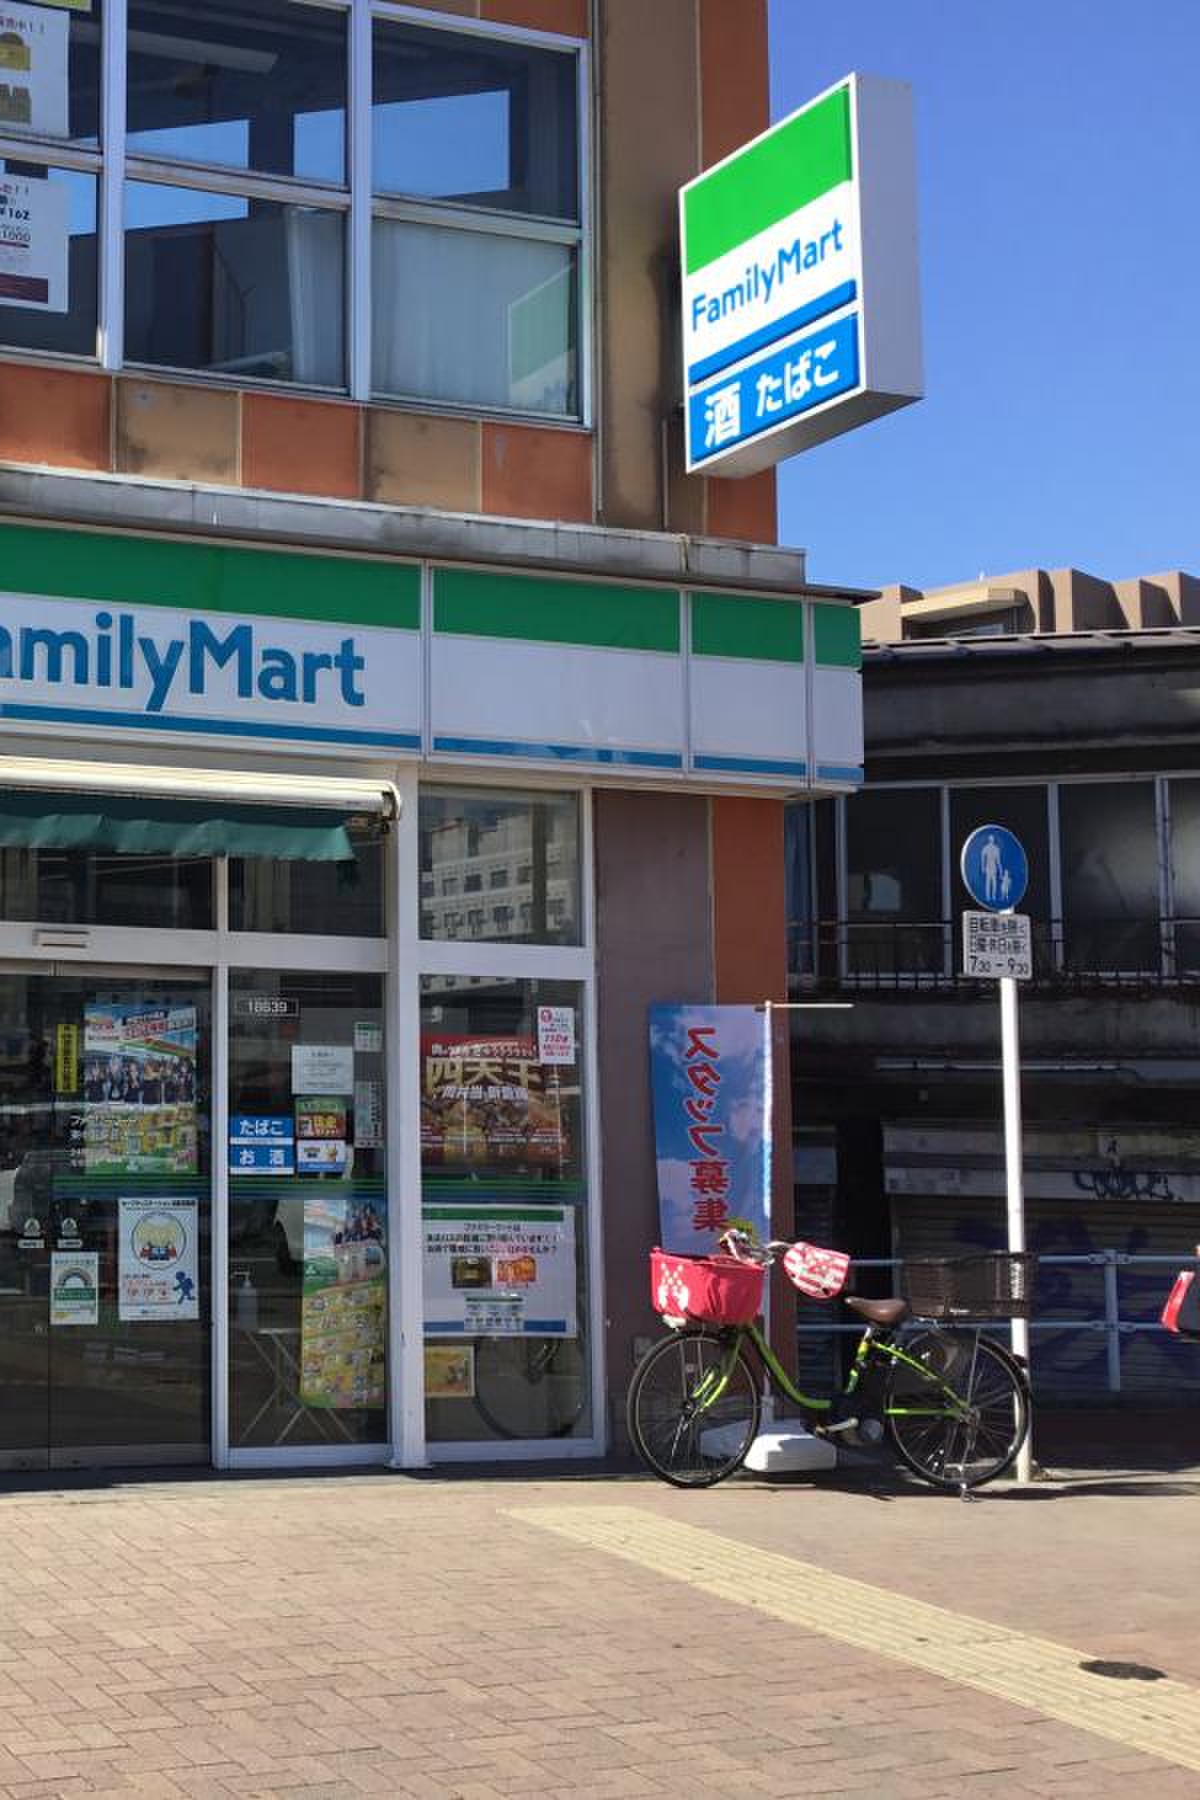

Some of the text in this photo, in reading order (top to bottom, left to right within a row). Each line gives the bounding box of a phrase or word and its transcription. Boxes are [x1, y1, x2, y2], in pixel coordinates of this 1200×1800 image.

[692, 218, 844, 333] FamilyMart
[704, 340, 841, 449] 酒 たばこ
[239, 1119, 284, 1136] たばこ
